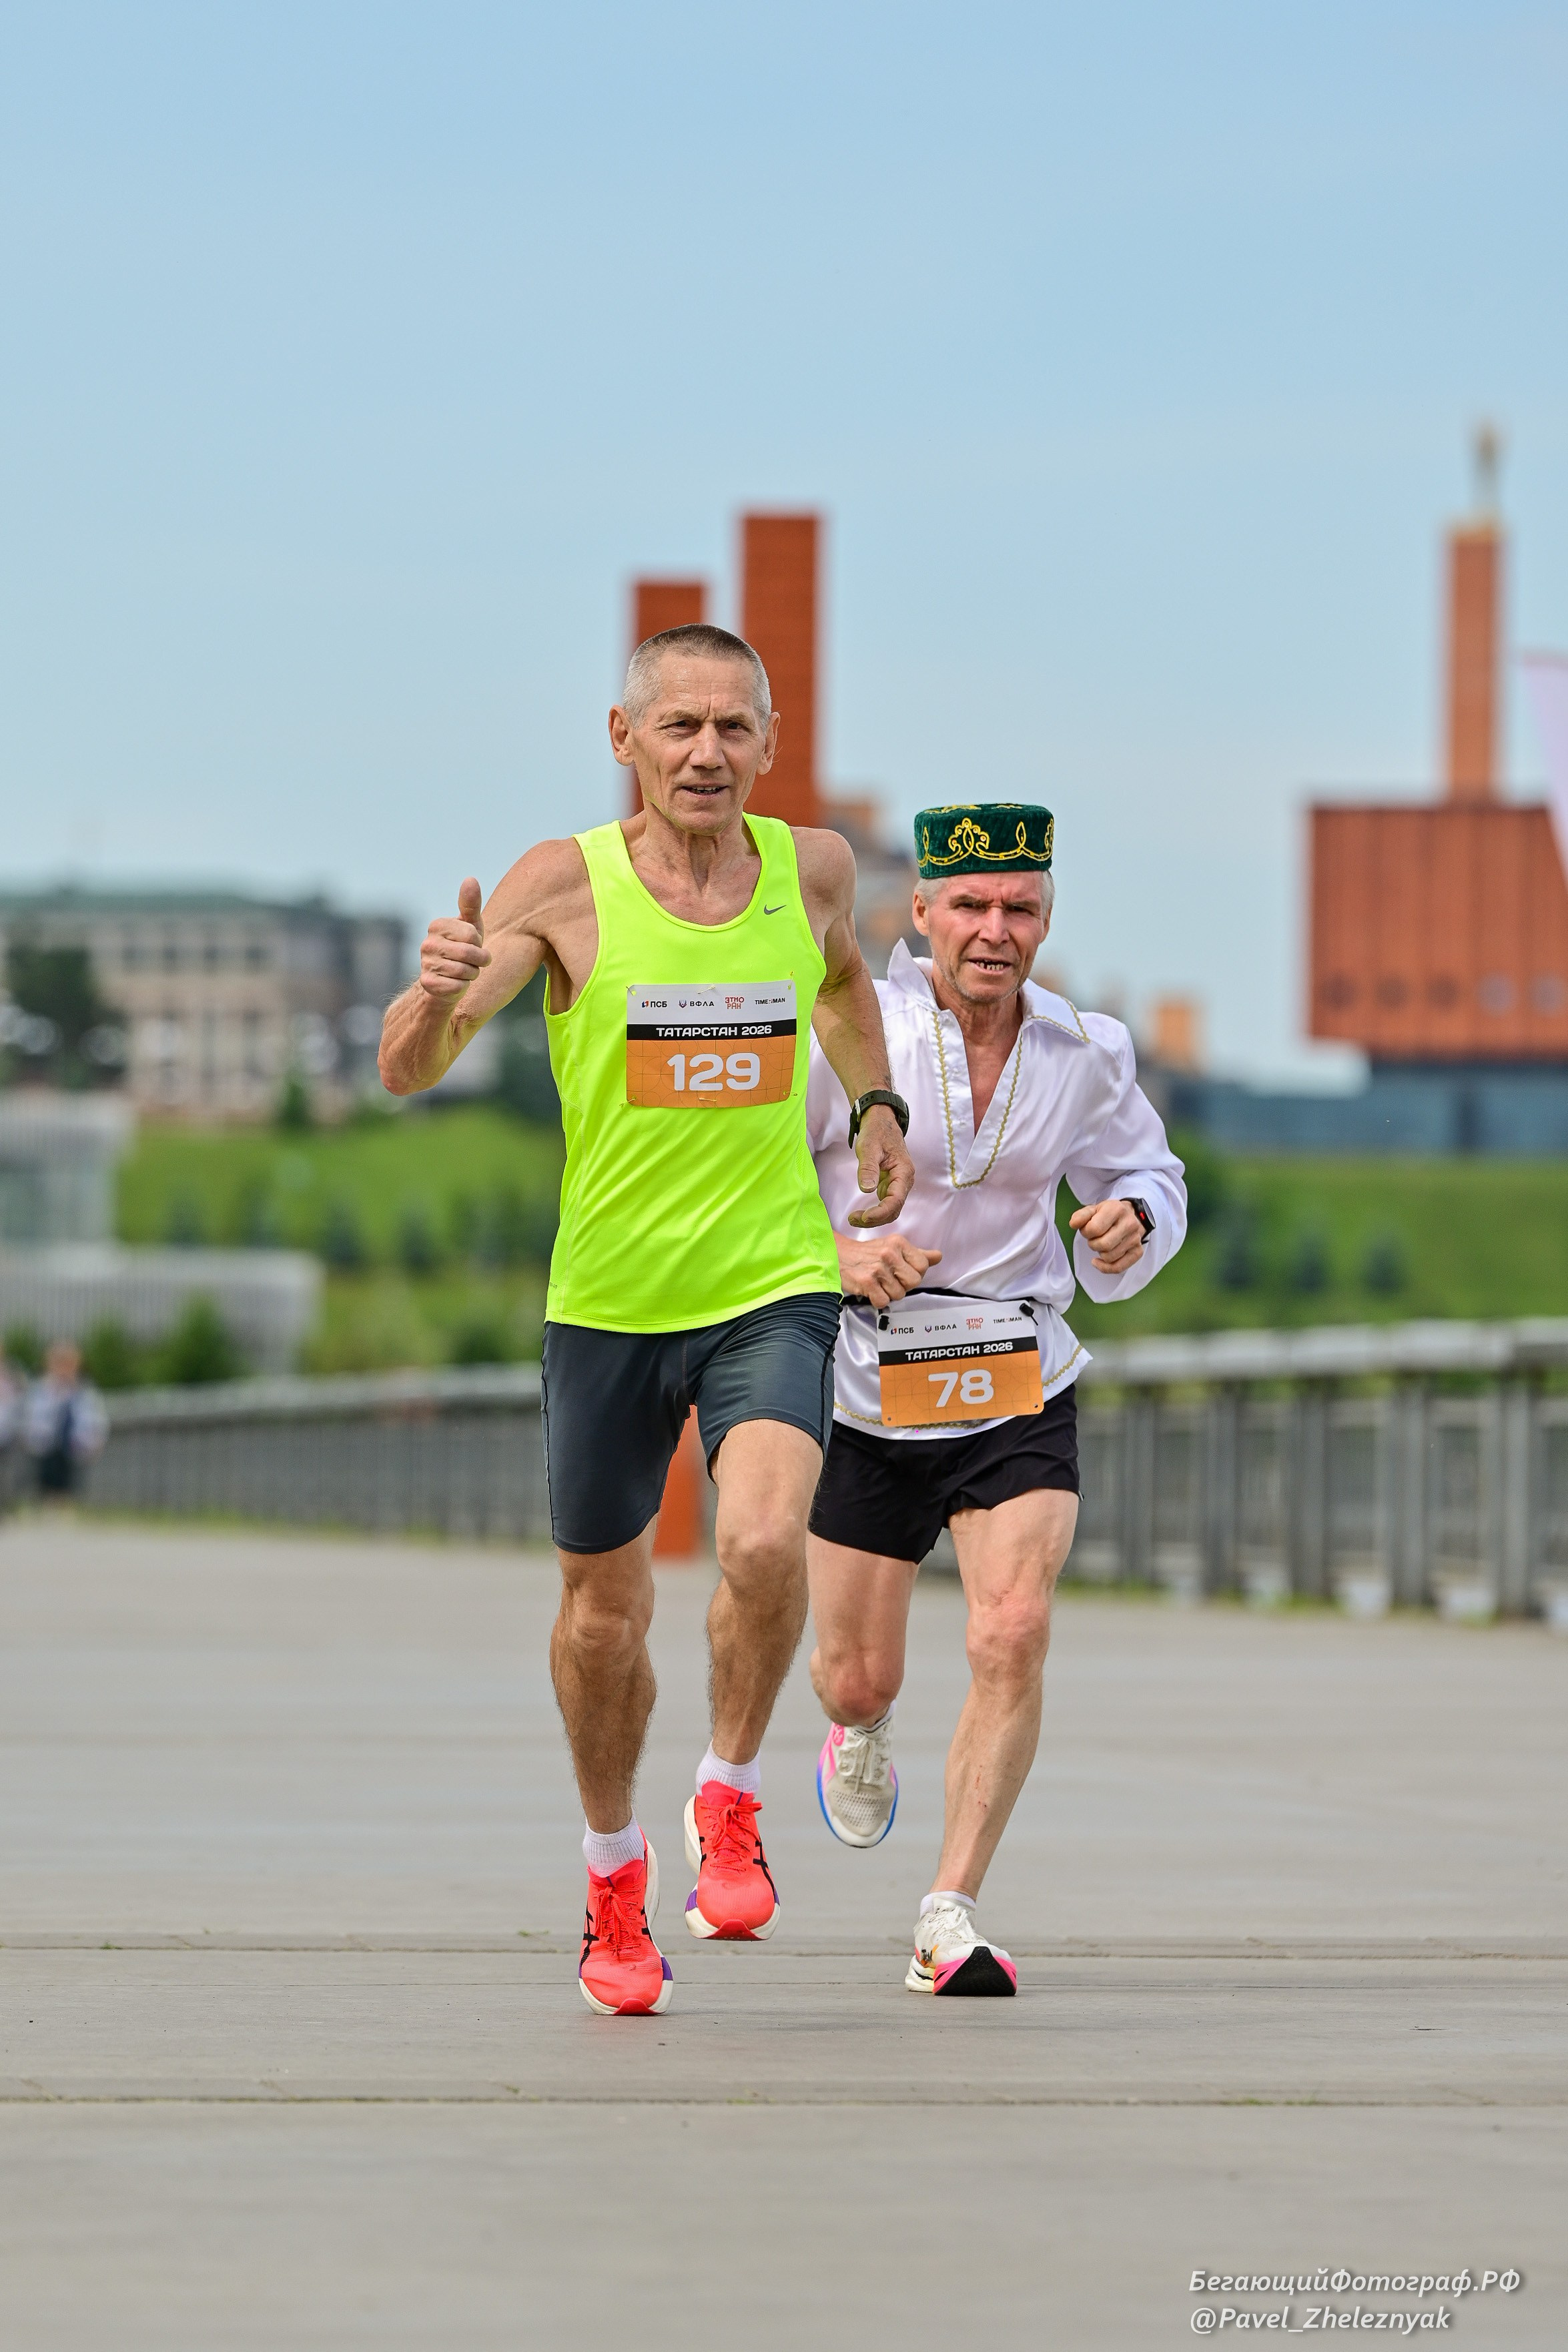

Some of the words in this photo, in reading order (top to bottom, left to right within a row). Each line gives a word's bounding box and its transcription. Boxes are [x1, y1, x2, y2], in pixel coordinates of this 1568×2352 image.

[656, 1026, 738, 1037] ТАТАРСТАН
[741, 1025, 772, 1036] 2026
[667, 1052, 761, 1091] 129
[898, 1326, 914, 1334] ПСБ
[935, 1323, 957, 1331] ВФЛА
[905, 1345, 980, 1361] ТАТАРСТАН
[983, 1341, 1014, 1354] 2026
[927, 1368, 994, 1408] 78
